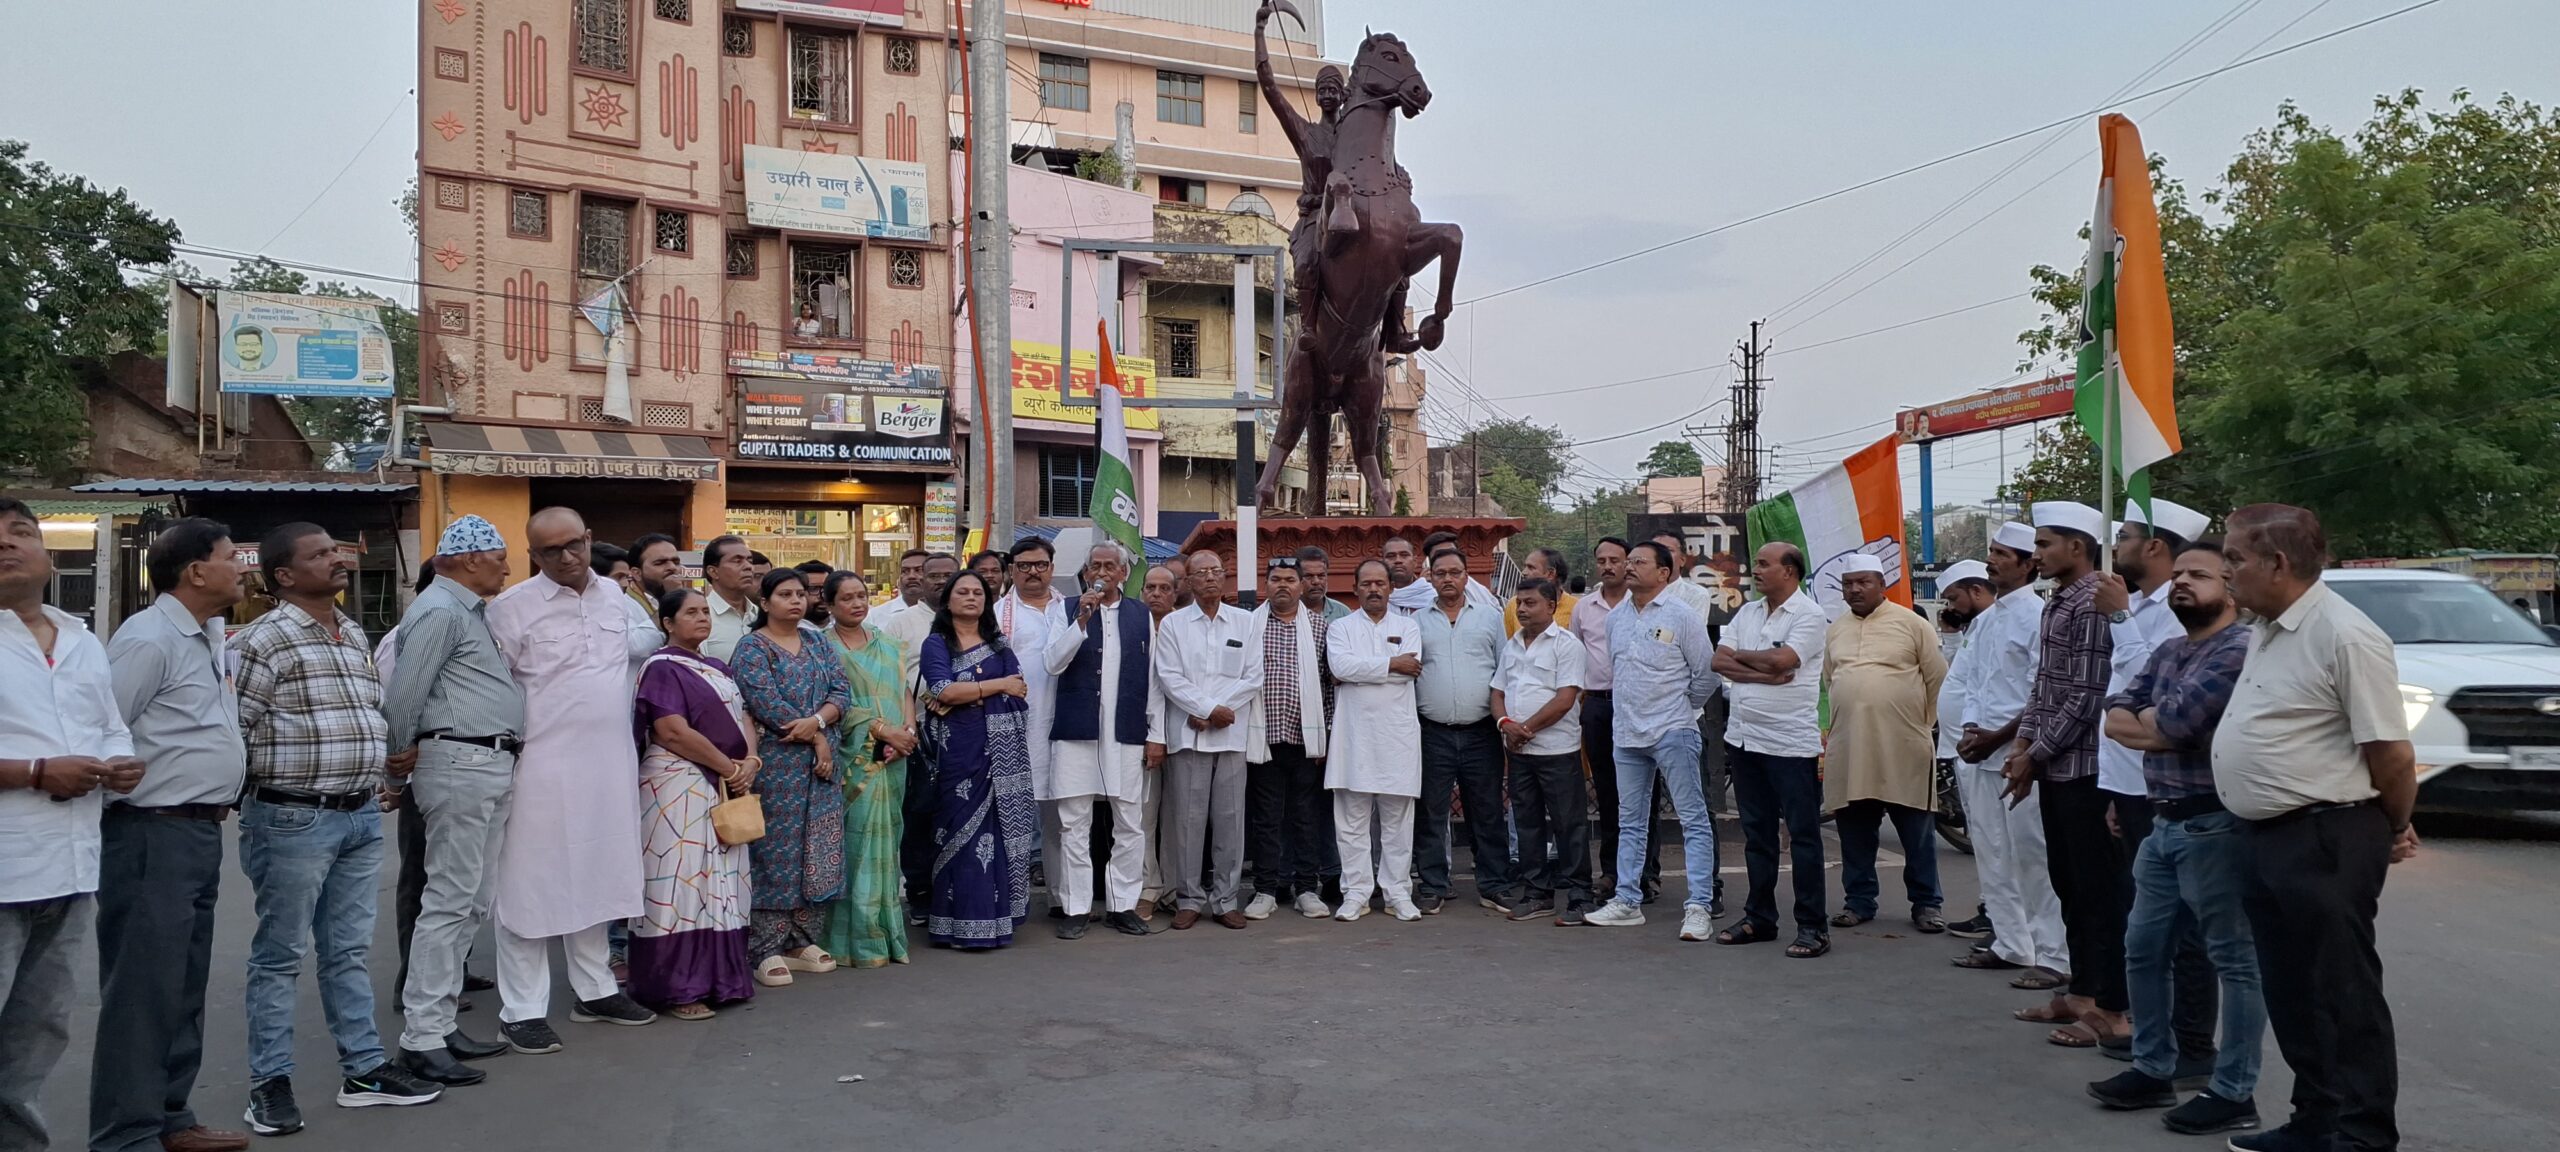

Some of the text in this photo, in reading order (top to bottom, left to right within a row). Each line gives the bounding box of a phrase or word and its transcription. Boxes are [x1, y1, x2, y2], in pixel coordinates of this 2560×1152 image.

[766, 171, 865, 197] उधारी चालू है
[746, 405, 801, 415] WHITE PUTTY
[1022, 394, 1046, 415] ब्यूरो
[746, 416, 773, 425] WHITE
[774, 417, 808, 427] CEMENT
[880, 411, 936, 431] Berger
[739, 441, 951, 460] GUPTA TRADERS & COMMUNICATION
[1681, 514, 1740, 560] नो
